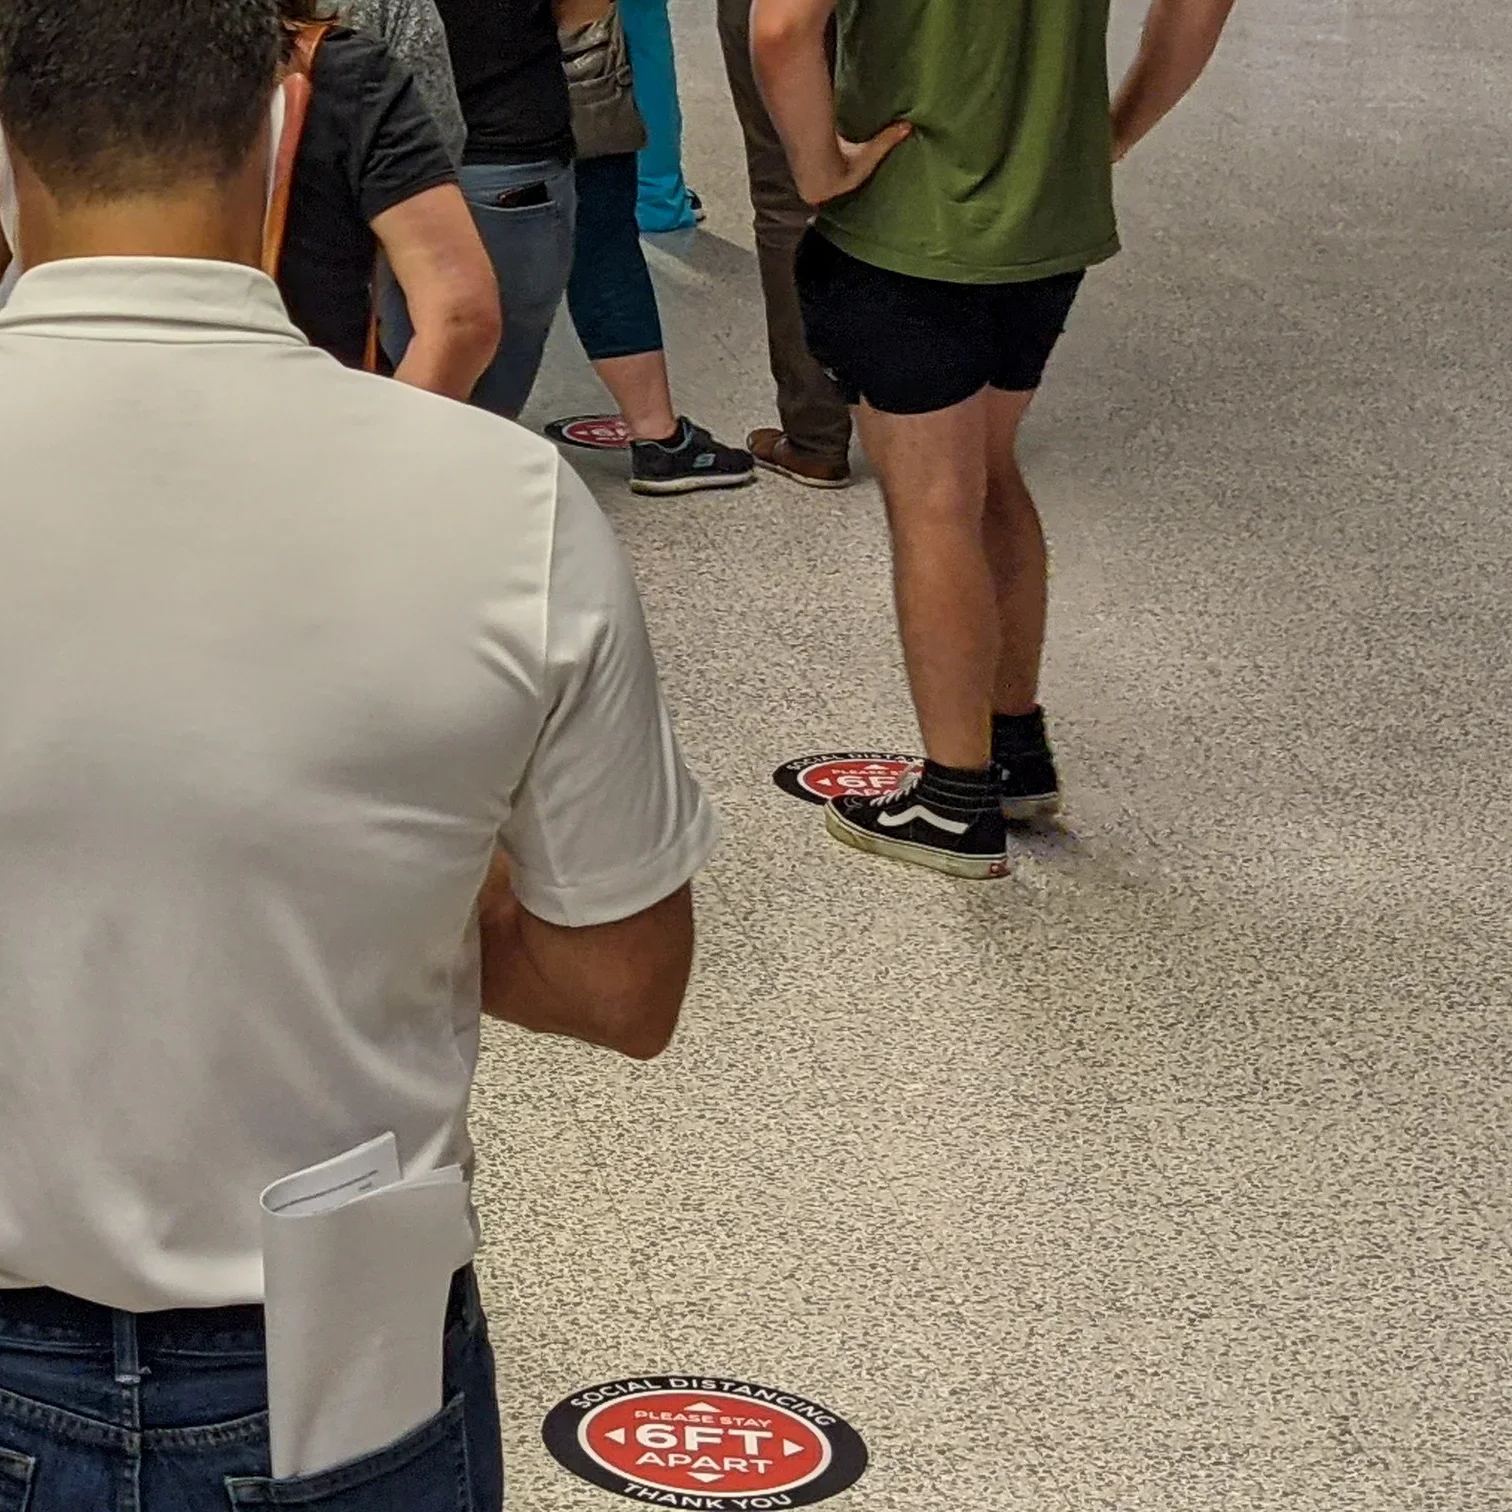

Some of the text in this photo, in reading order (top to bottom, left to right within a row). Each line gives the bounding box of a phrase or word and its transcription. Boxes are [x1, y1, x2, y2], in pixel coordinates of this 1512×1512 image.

[570, 1378, 837, 1427] SOCIAL DISTANCING
[635, 1410, 772, 1428] PLEASE STAY
[635, 1424, 774, 1456] 6FT
[635, 1452, 774, 1474] APART
[623, 1483, 793, 1510] THANK YOU
